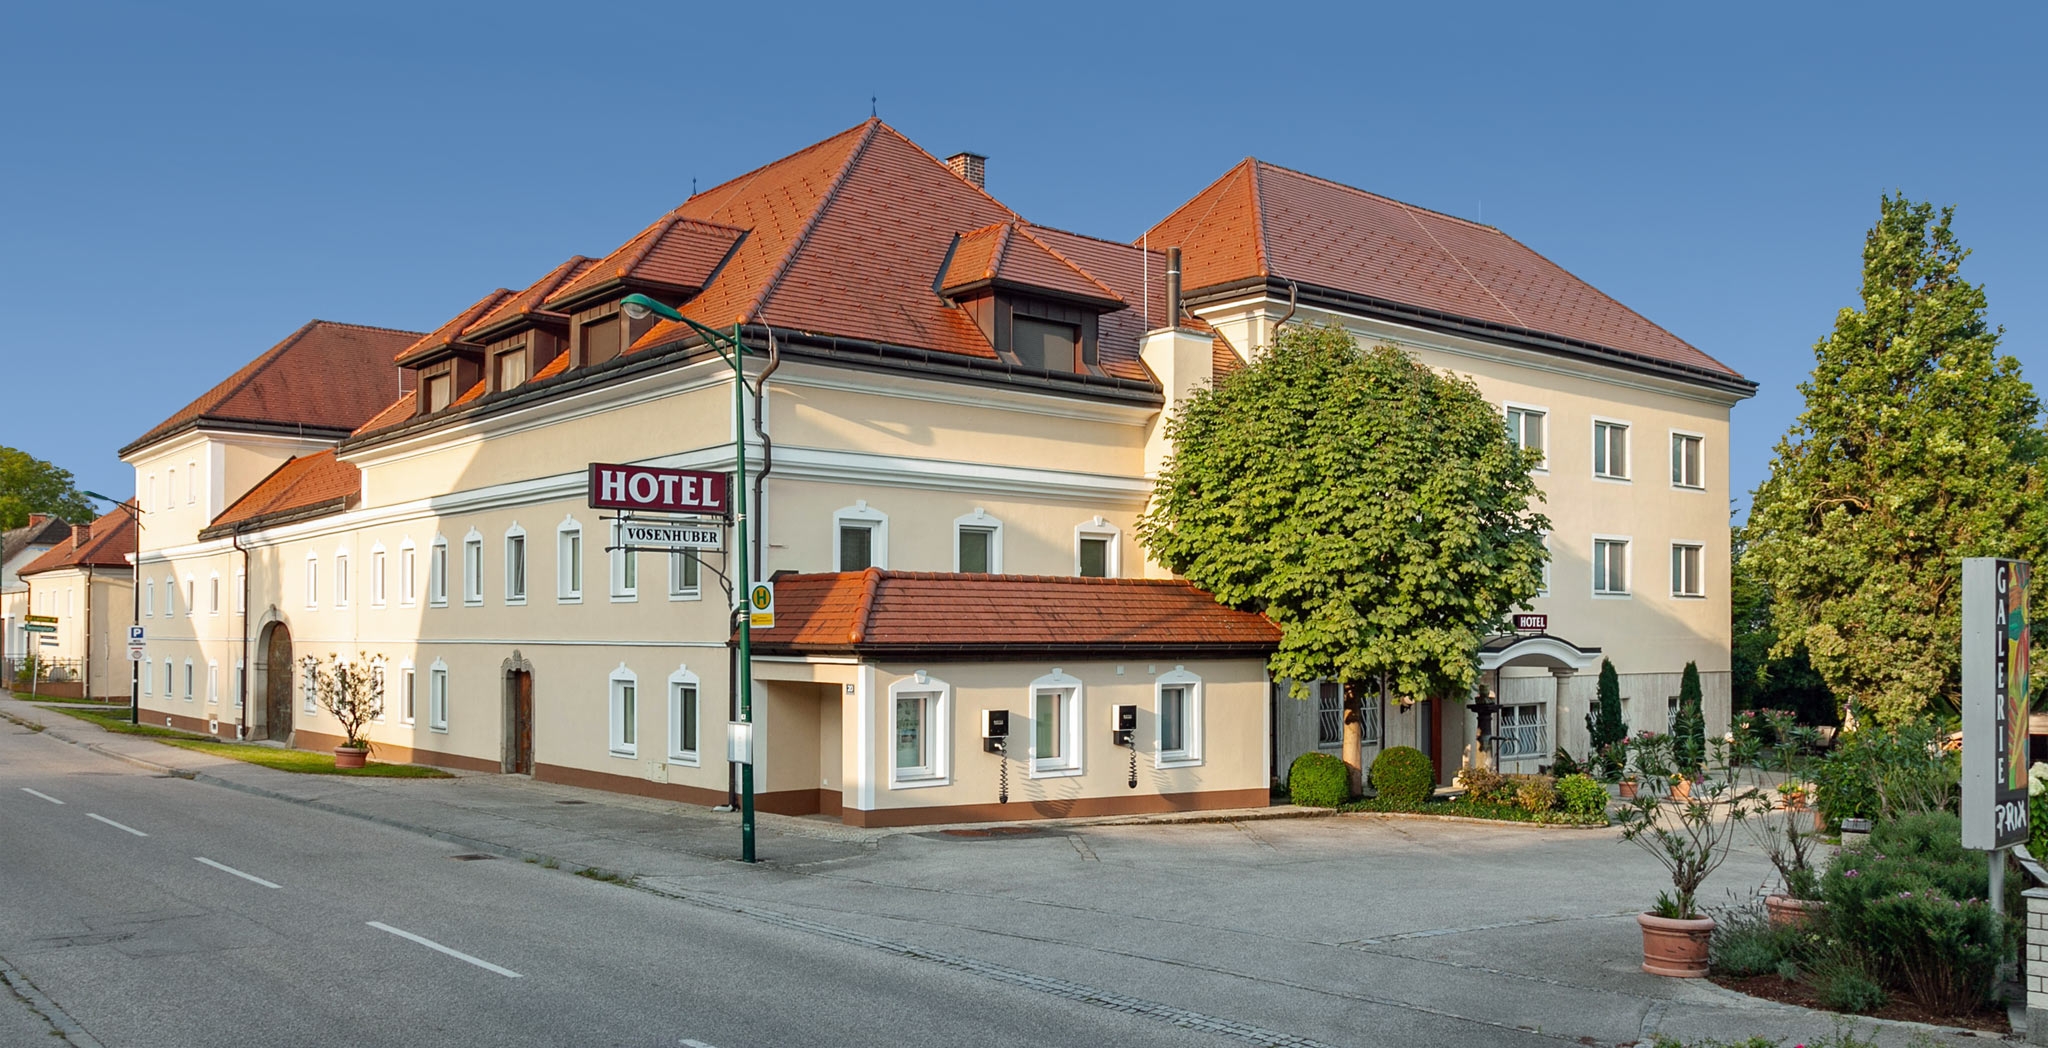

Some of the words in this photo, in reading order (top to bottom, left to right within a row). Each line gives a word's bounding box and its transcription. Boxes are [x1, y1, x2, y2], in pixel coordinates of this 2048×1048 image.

[601, 470, 720, 507] HOTEL
[757, 590, 767, 605] H
[133, 628, 141, 638] P
[1520, 616, 1545, 627] HOTEL
[1997, 566, 2007, 785] GALERIE
[1995, 800, 2027, 837] PRIX
